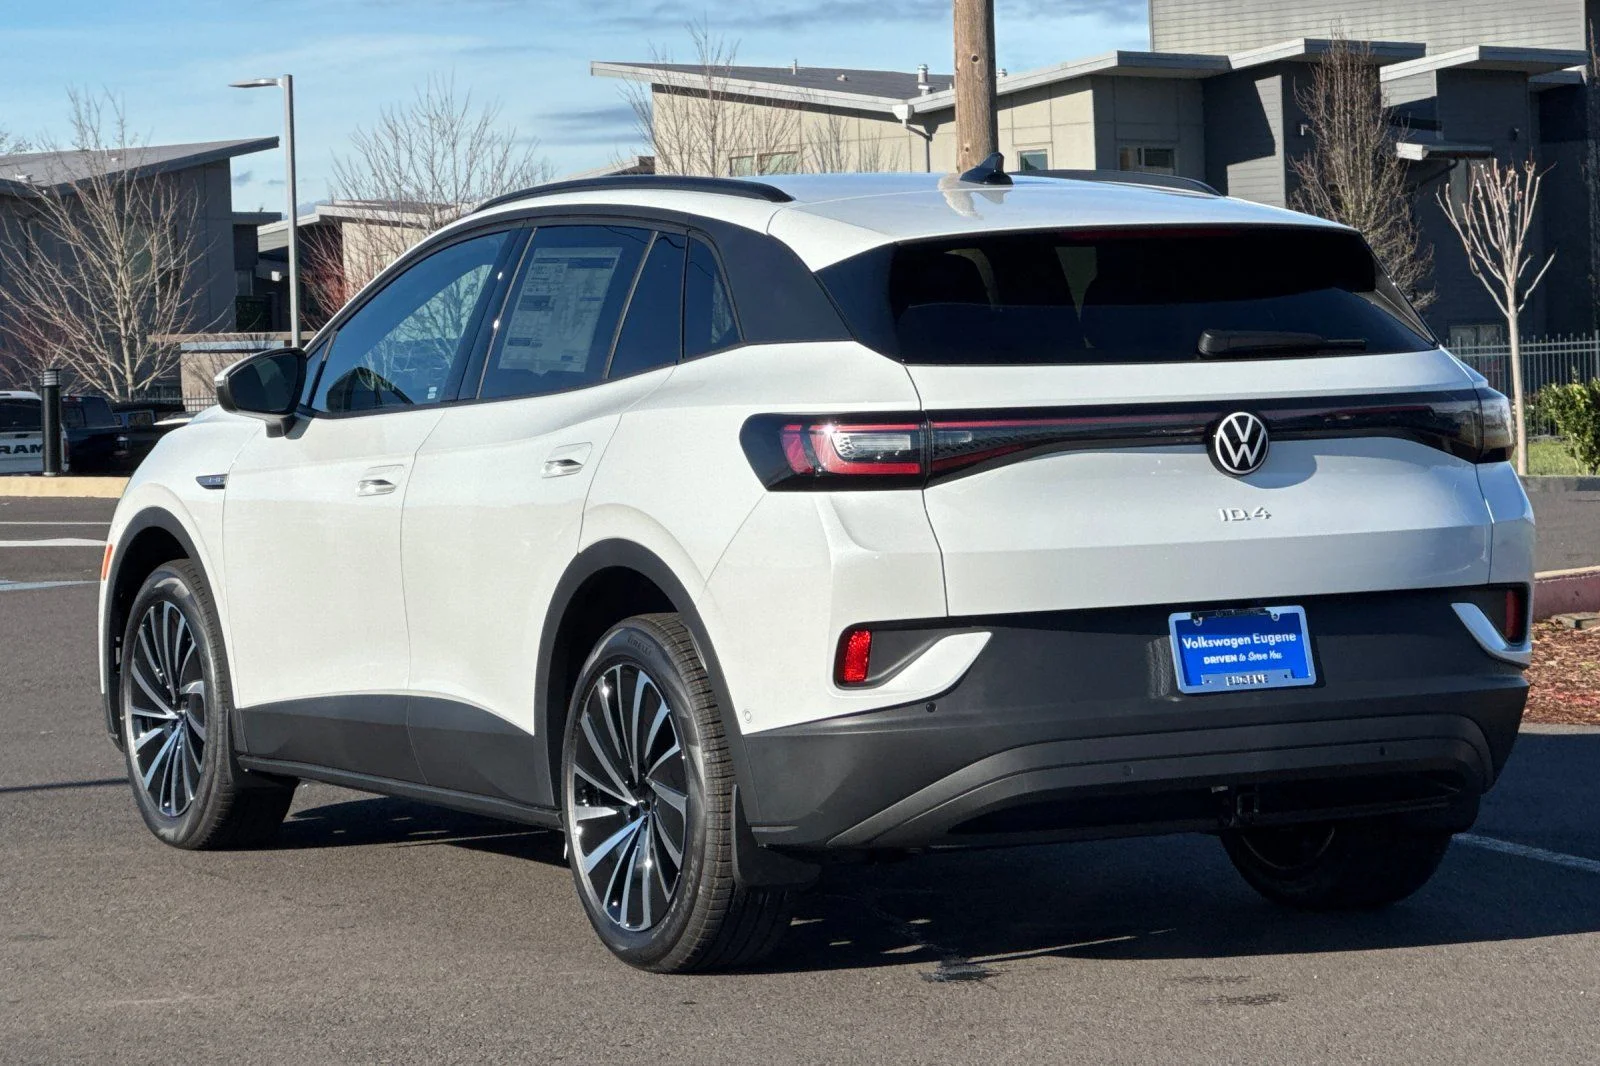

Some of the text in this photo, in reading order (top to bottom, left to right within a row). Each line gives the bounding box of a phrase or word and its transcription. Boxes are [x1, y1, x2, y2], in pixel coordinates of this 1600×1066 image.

[0, 444, 43, 454] RAM
[1182, 633, 1297, 649] Volkswagen Eugene
[1203, 654, 1237, 665] DRIVEN
[1238, 653, 1246, 661] to
[1248, 651, 1268, 661] Serve
